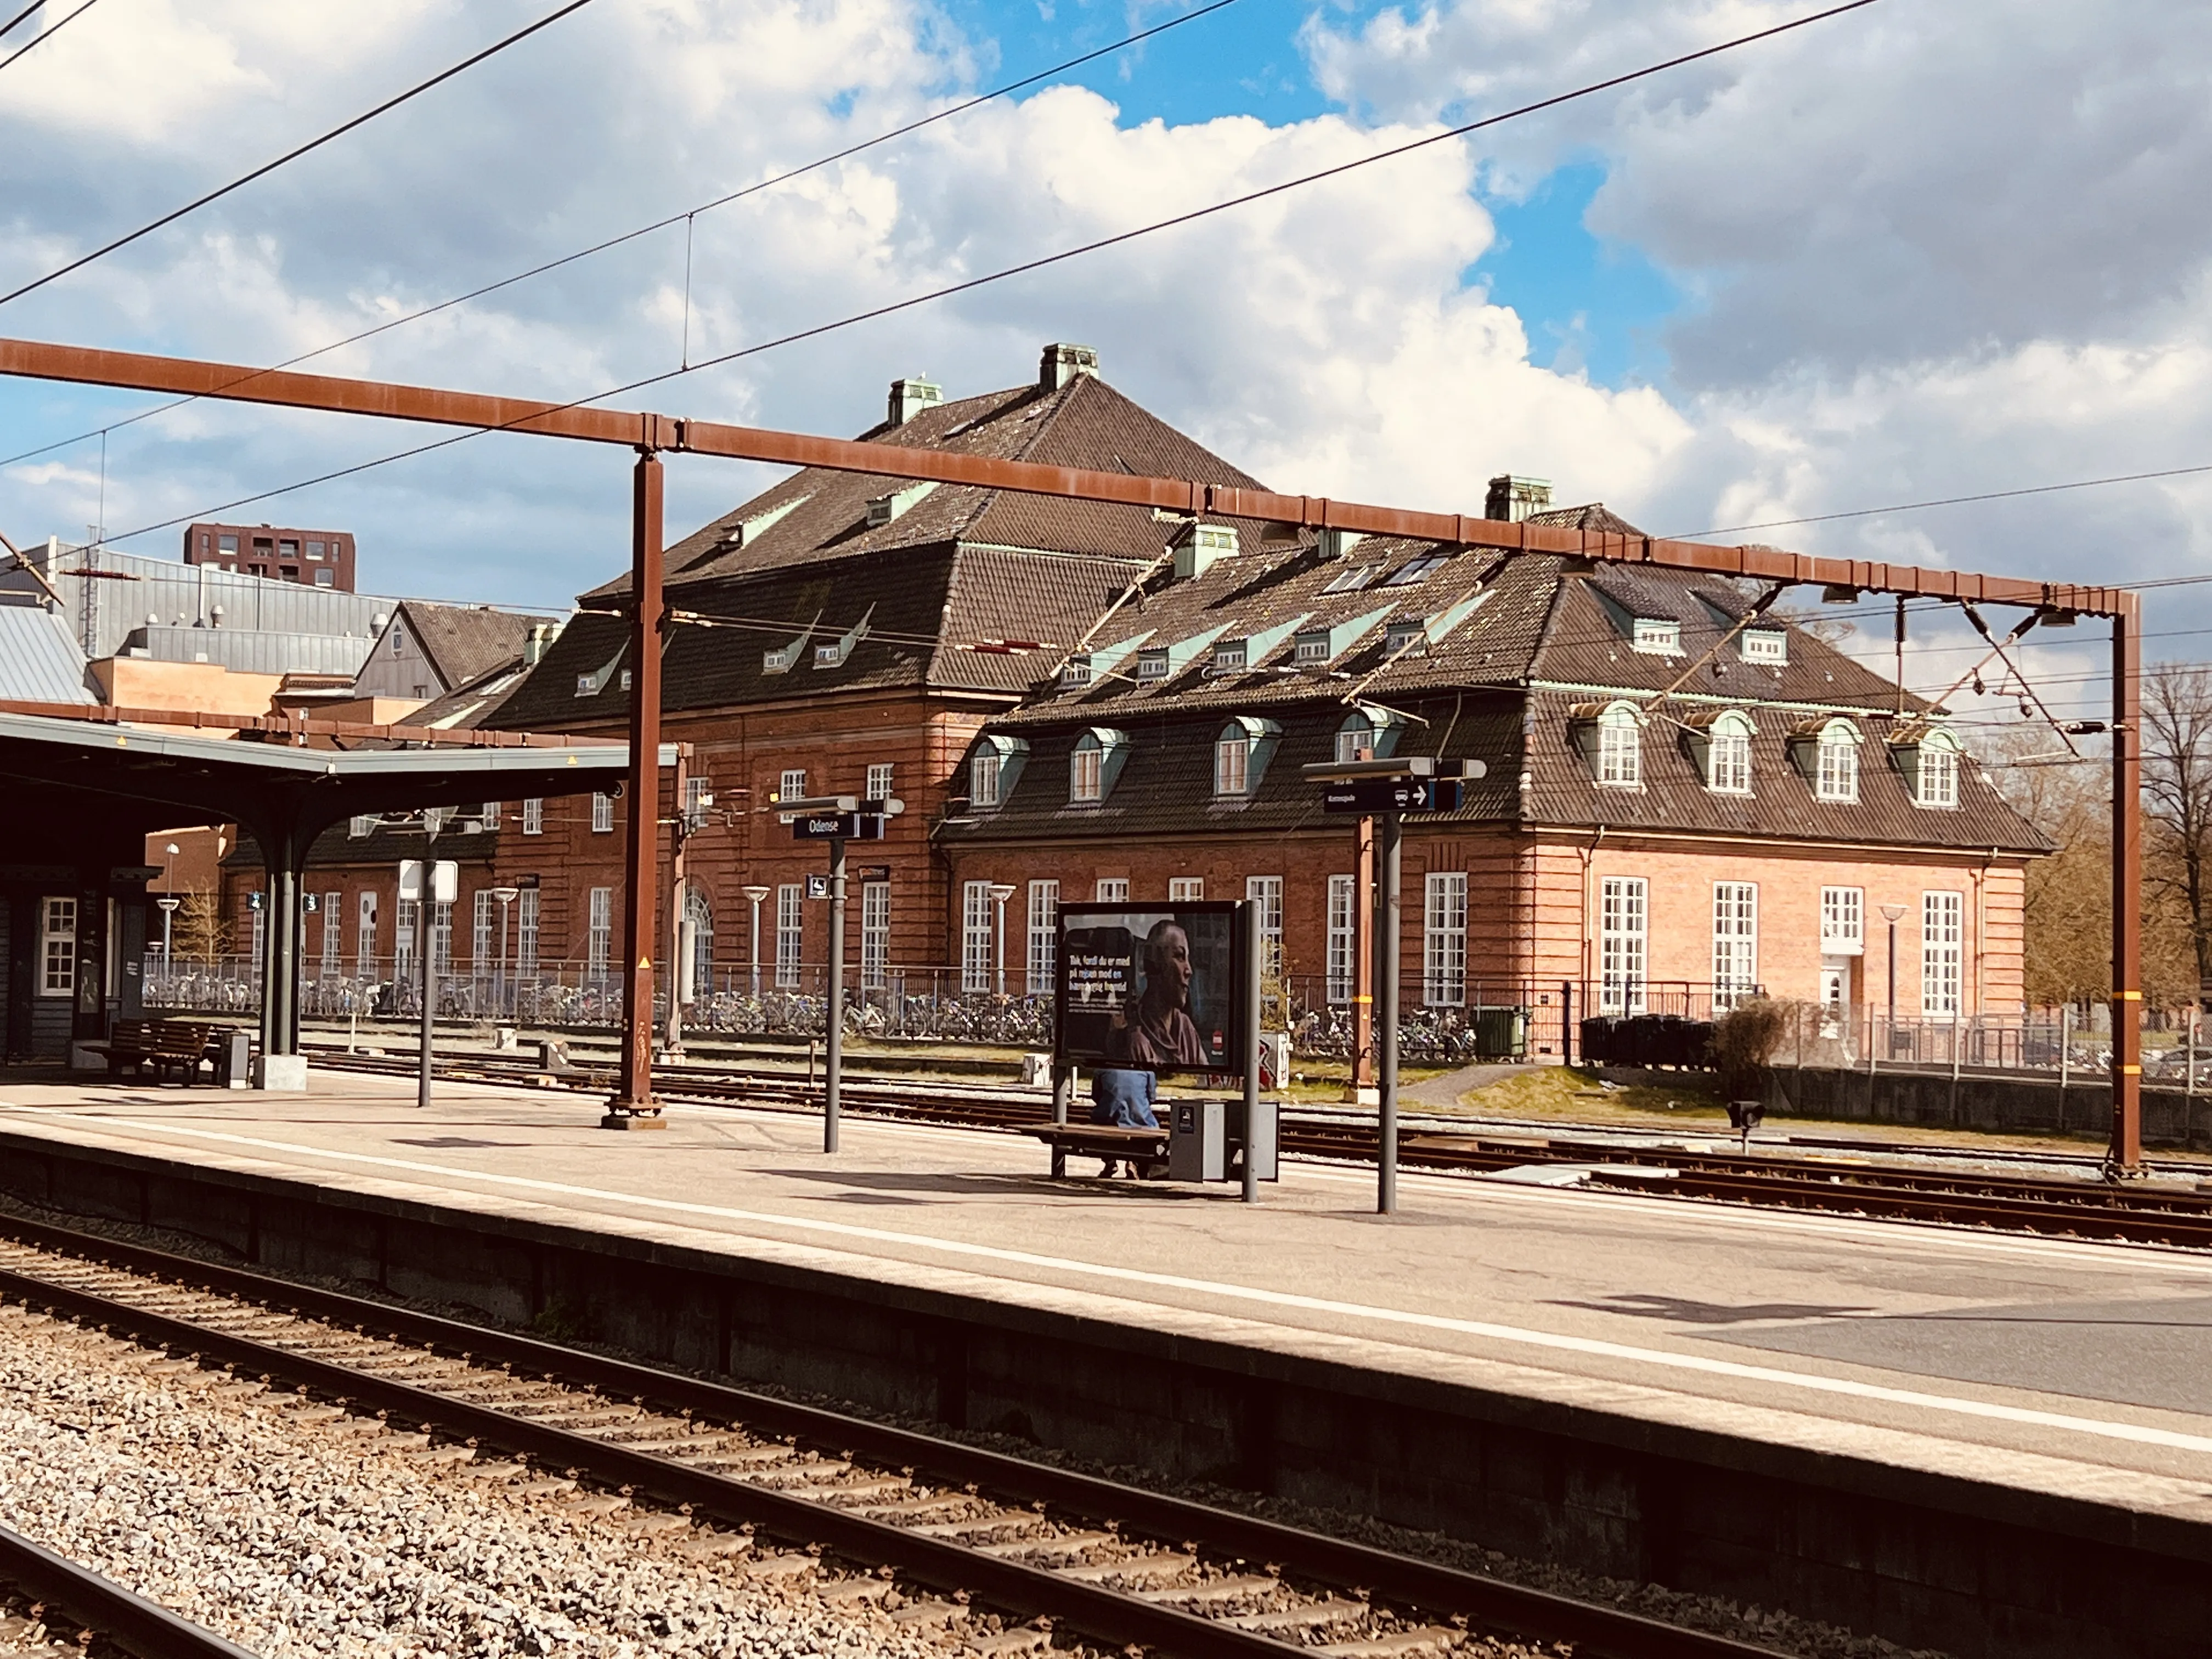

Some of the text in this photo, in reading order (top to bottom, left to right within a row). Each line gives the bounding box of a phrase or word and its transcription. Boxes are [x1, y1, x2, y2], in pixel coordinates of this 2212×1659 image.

[809, 819, 838, 833] Odense
[1098, 955, 1107, 966] du
[1108, 957, 1115, 966] er
[1115, 956, 1130, 966] med
